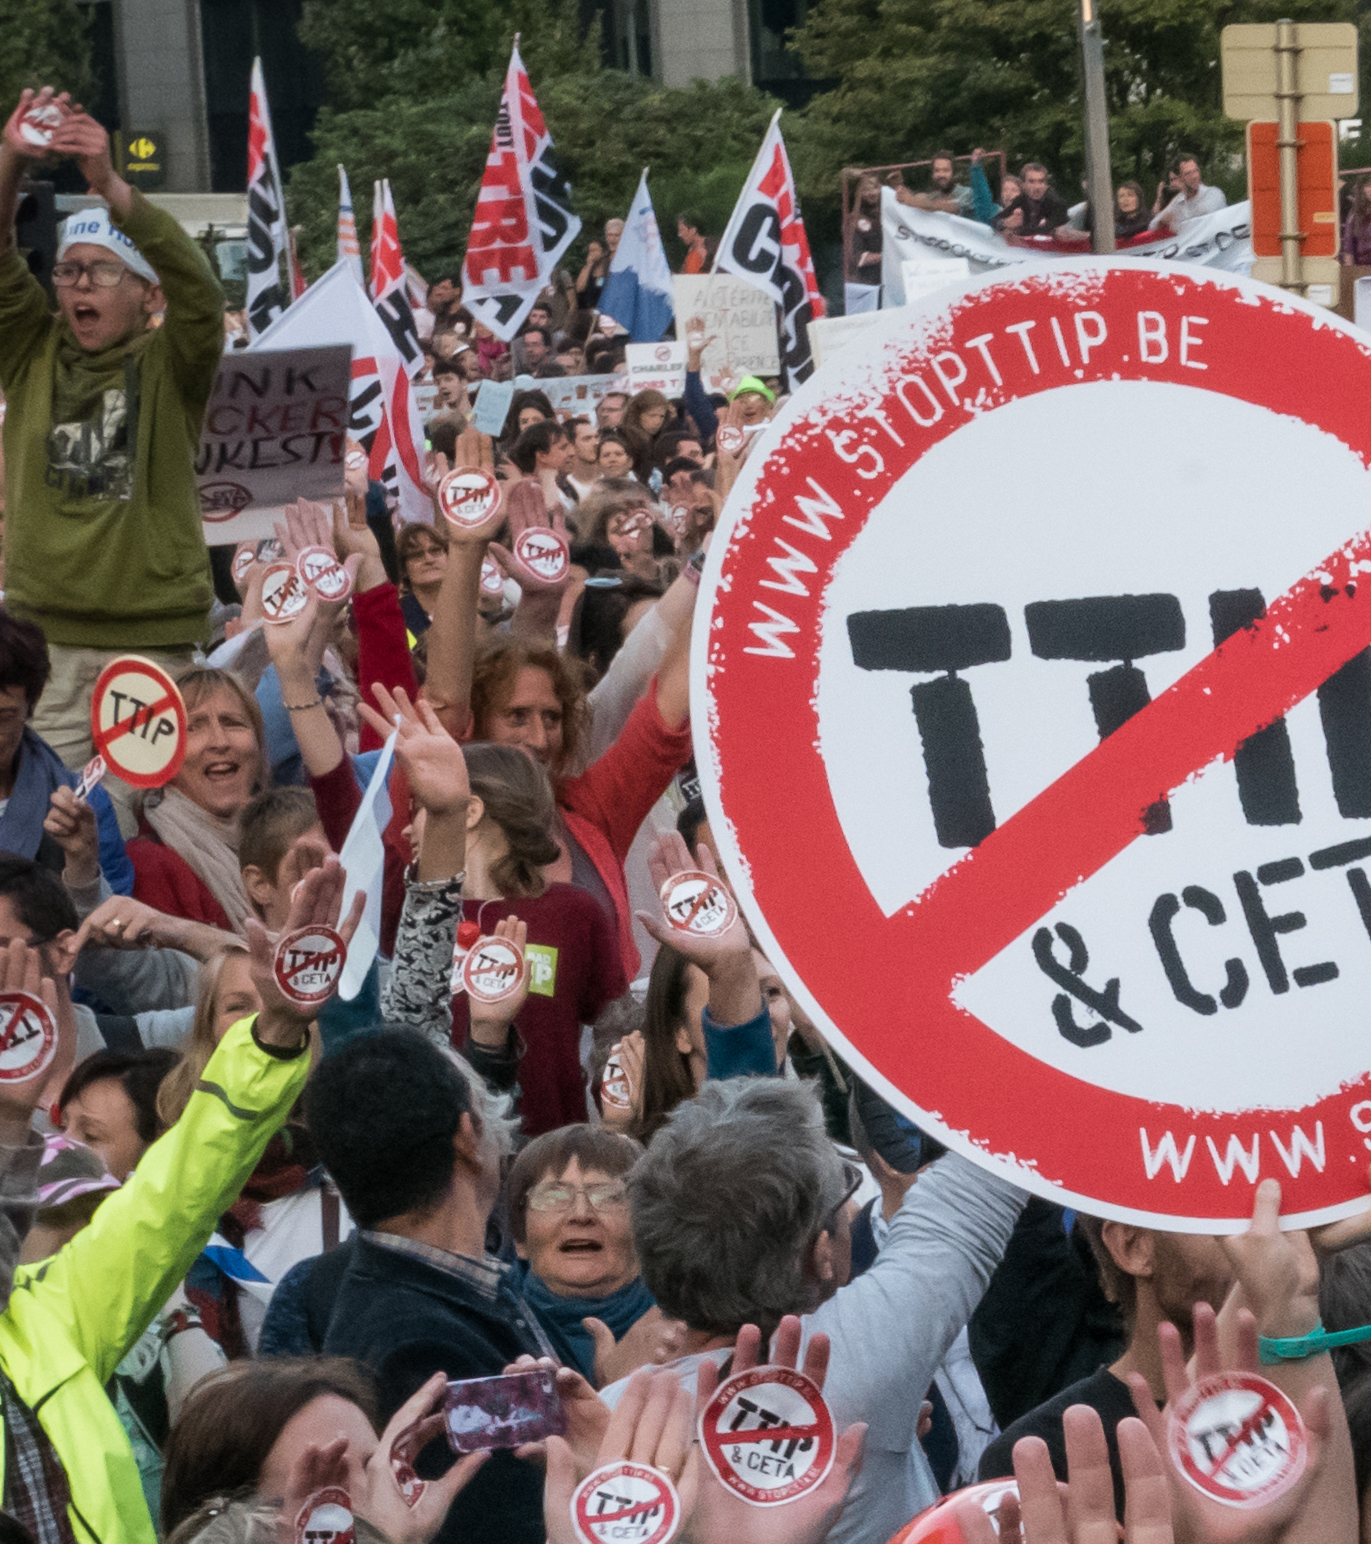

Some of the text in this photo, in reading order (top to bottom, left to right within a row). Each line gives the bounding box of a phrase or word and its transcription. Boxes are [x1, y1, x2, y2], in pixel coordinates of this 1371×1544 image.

[110, 689, 175, 746] TTIP
[671, 886, 718, 919] TTIP
[288, 949, 338, 972] TTIP
[479, 953, 515, 980] TTIP
[1031, 921, 1143, 1048] &
[730, 1397, 814, 1460] TTIP
[746, 1449, 796, 1480] CETA
[597, 1491, 659, 1524] TTIP
[611, 1525, 650, 1539] CETA
